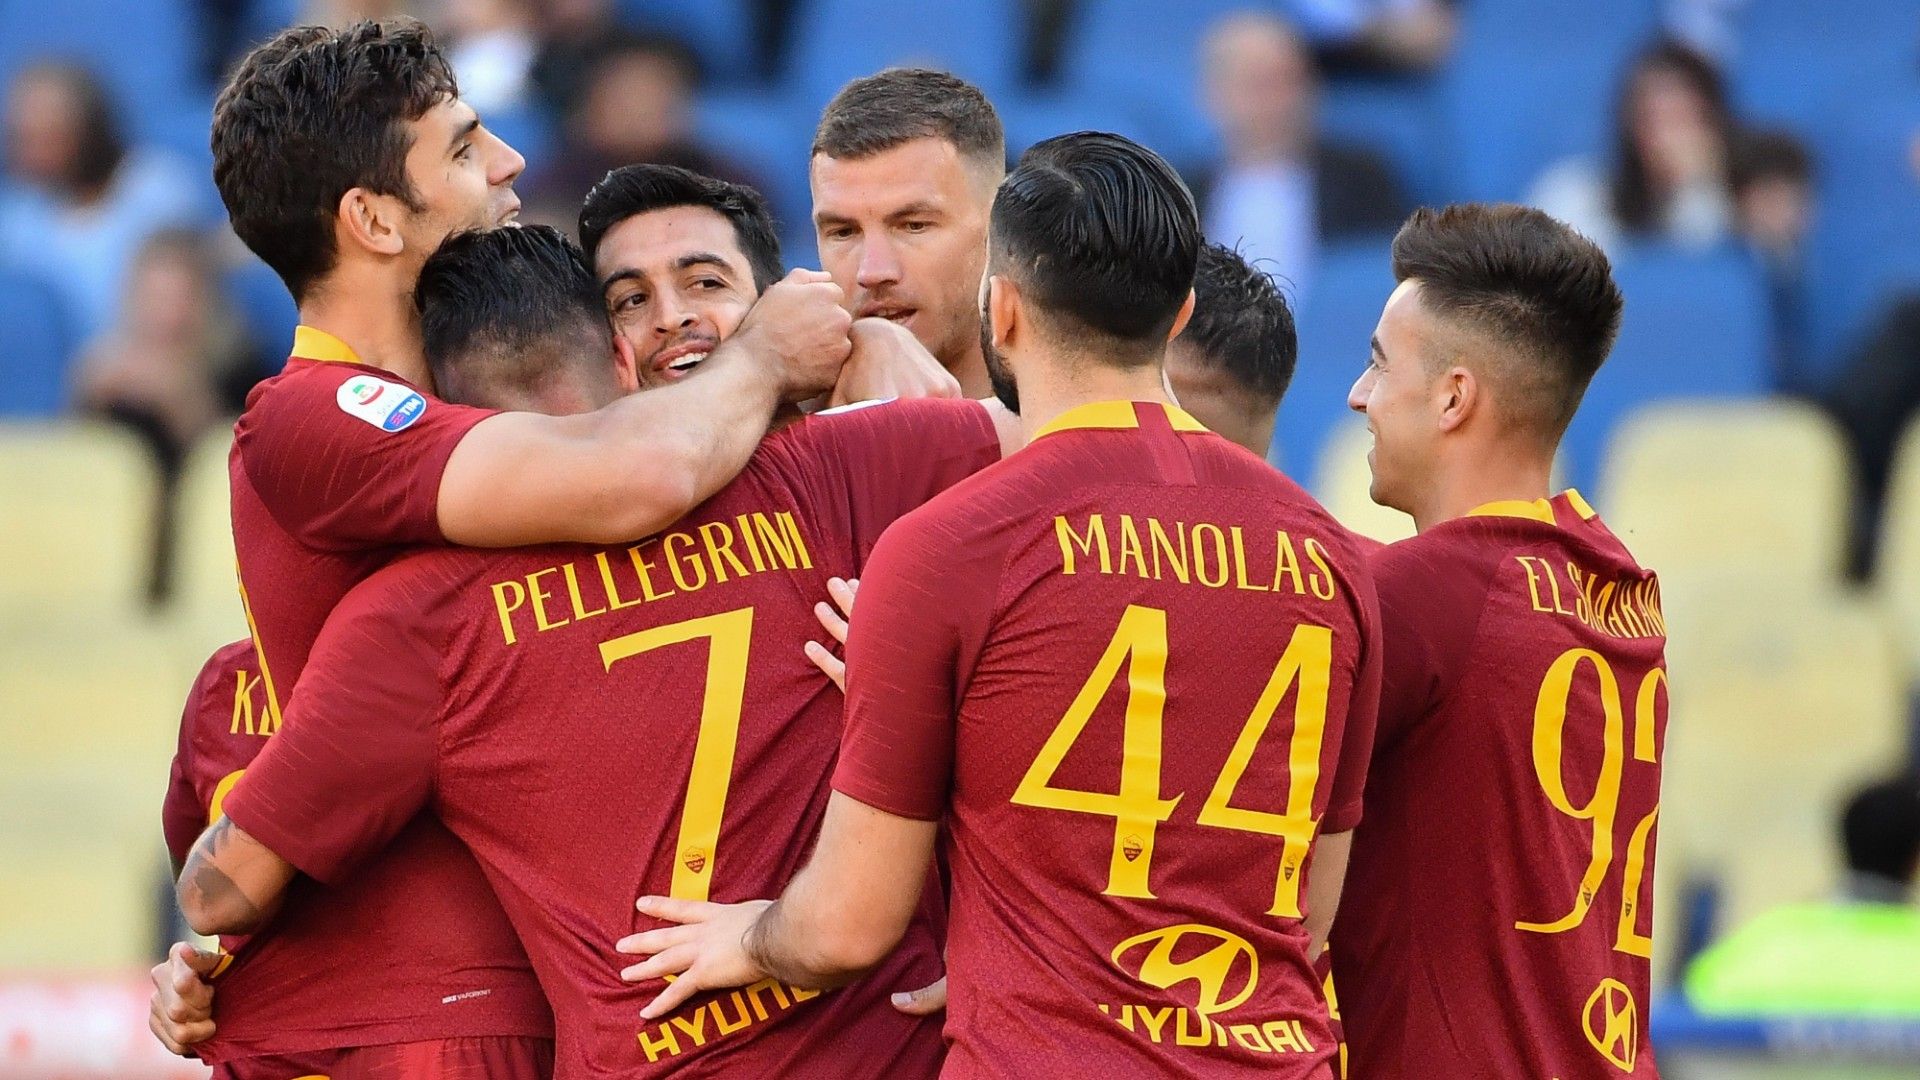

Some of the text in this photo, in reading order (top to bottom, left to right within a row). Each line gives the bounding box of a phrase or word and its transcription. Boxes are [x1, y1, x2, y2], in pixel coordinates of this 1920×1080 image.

[490, 510, 814, 646] PELLEGRINI
[1054, 513, 1336, 601] MANOLAS
[1514, 556, 1574, 616] EL
[598, 606, 754, 903] 7
[1010, 604, 1333, 919] 44
[1514, 647, 1670, 959] 92
